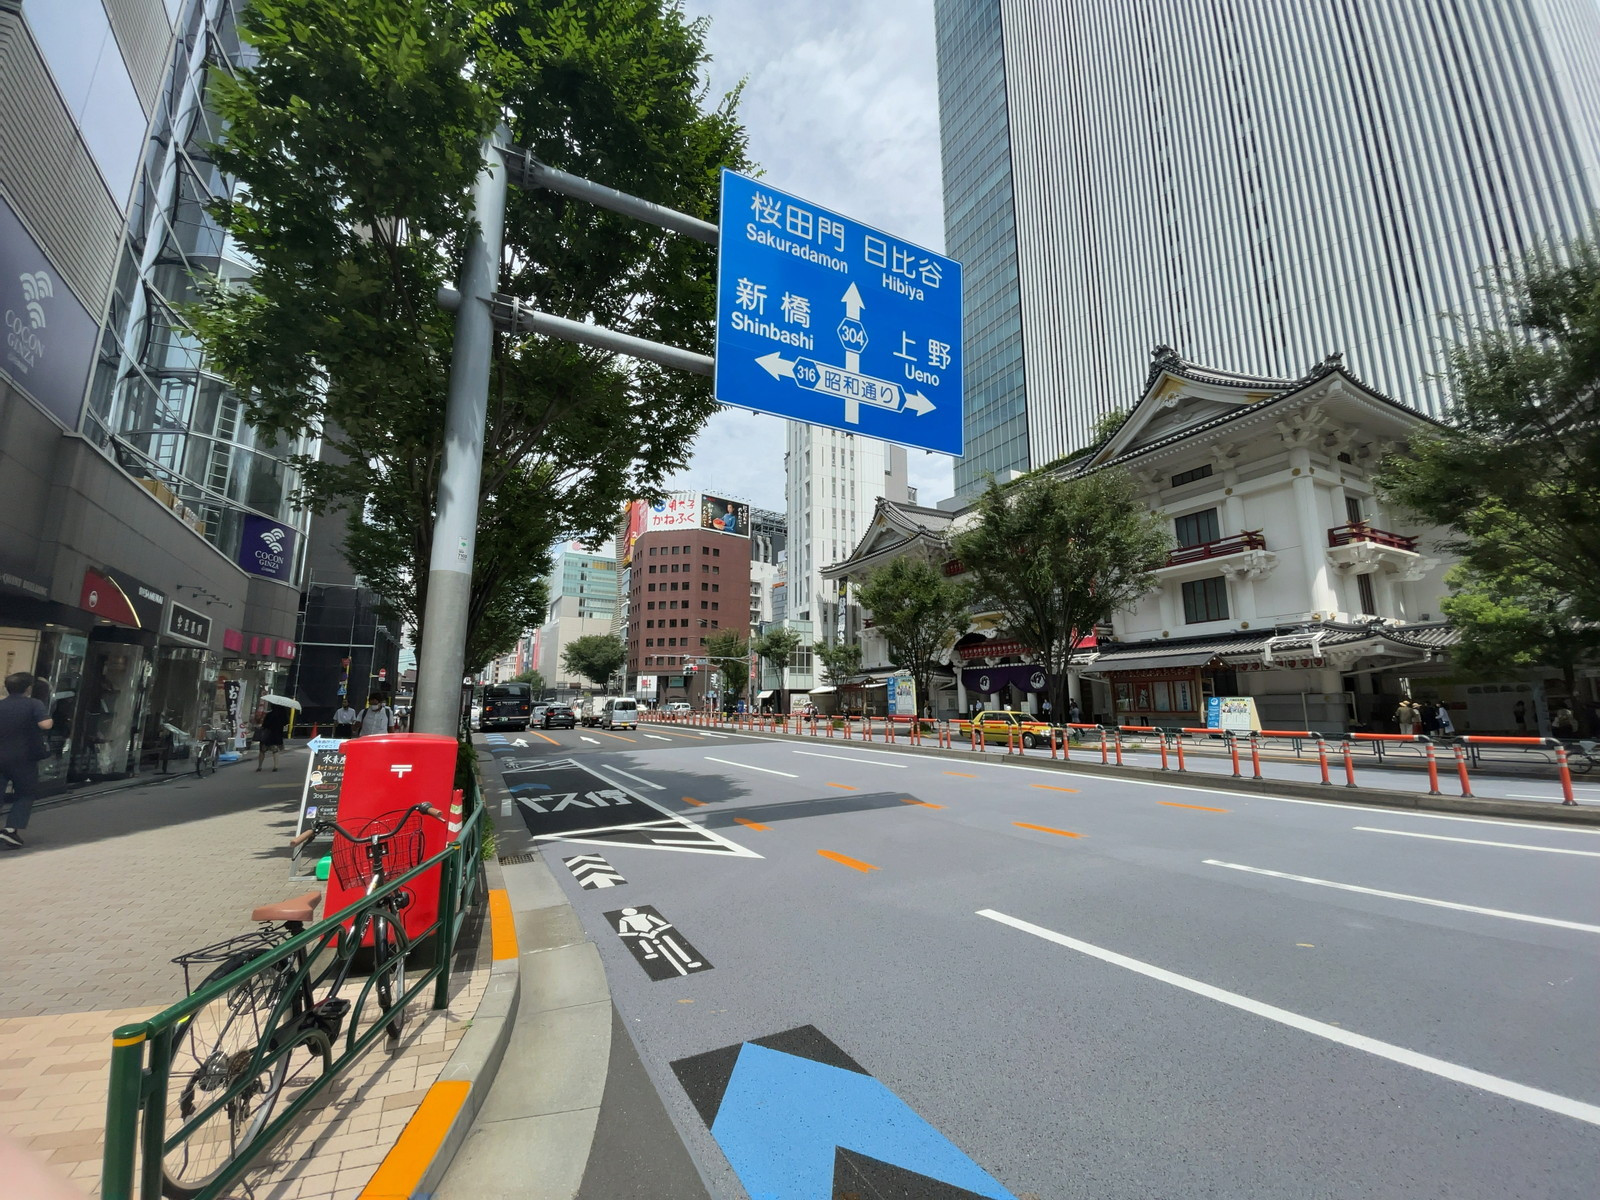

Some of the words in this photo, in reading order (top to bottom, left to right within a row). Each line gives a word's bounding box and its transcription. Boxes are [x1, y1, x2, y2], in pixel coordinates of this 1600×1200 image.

[751, 191, 845, 252] 桜田門
[865, 234, 943, 289] 日比谷
[746, 223, 848, 274] Sakuradamon
[882, 273, 924, 301] Hibiya
[736, 277, 811, 328] 新橋
[5, 309, 45, 358] COCON
[731, 311, 814, 351] Shinbashi
[841, 324, 865, 347] 304
[893, 330, 951, 370] 上野
[797, 365, 816, 382] 316
[824, 370, 893, 404] 昭和通り
[905, 363, 940, 387] Ueno
[653, 513, 695, 526] かねふく
[255, 550, 284, 565] COCON
[259, 559, 279, 569] GINZA
